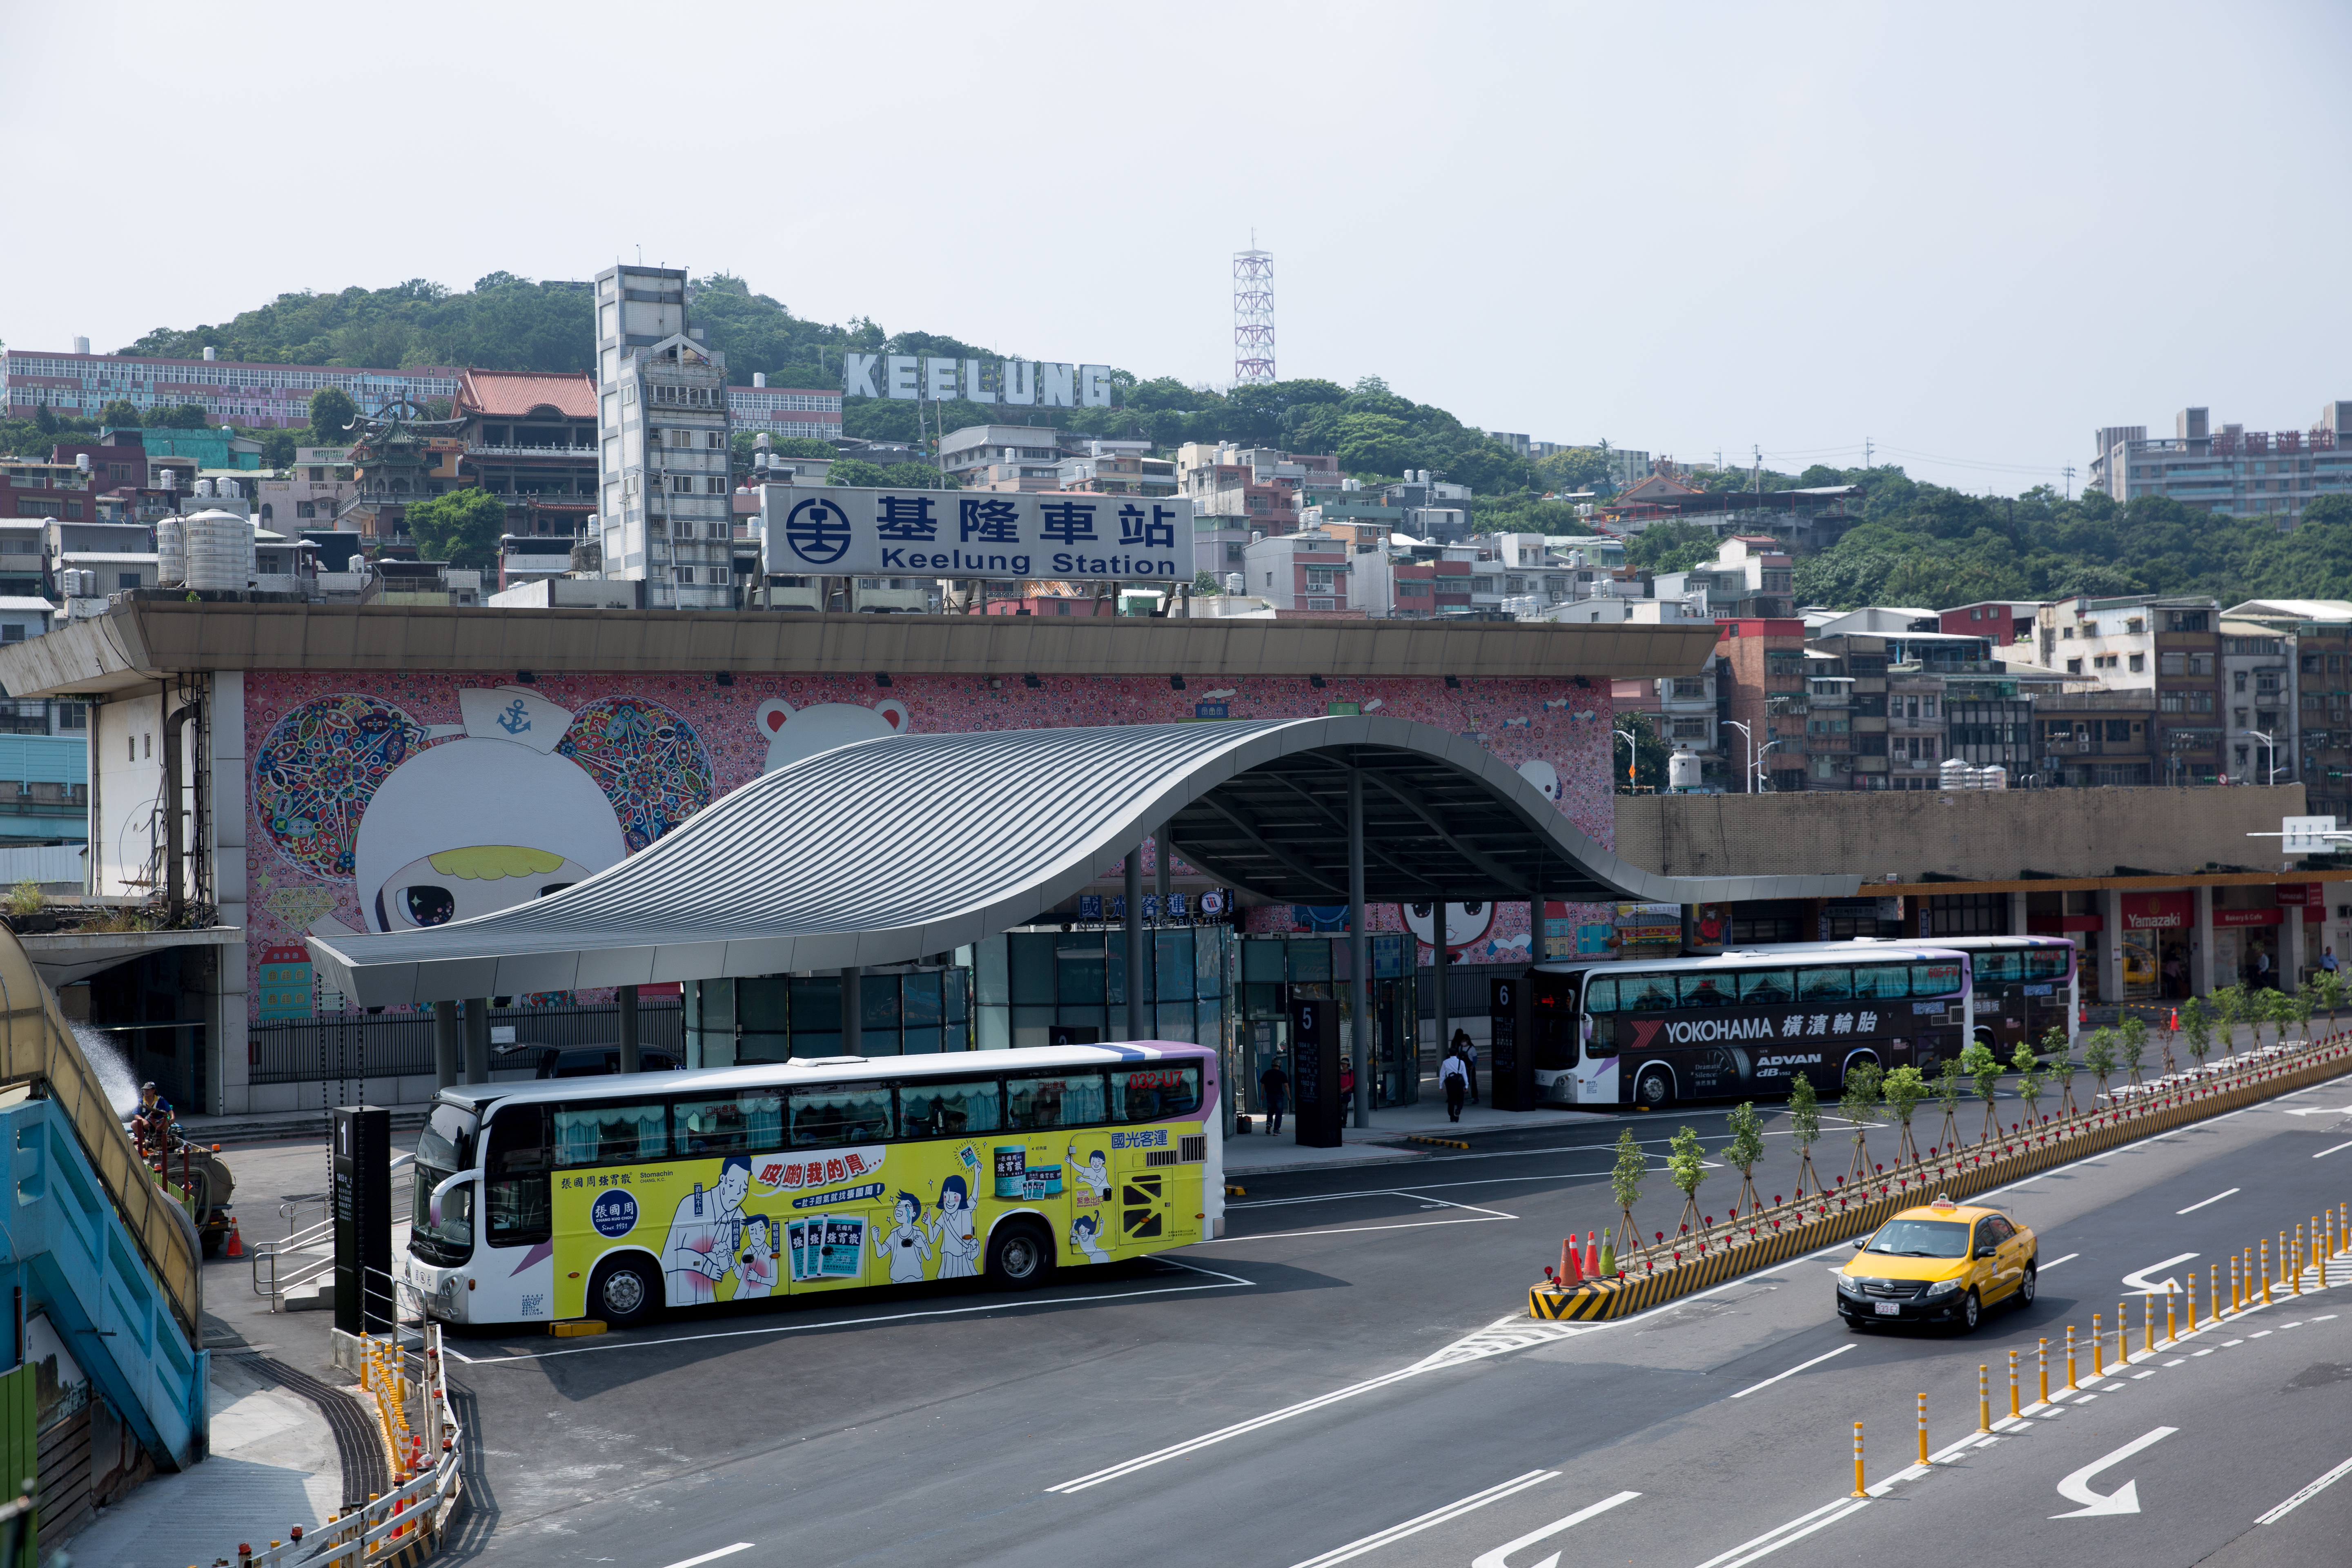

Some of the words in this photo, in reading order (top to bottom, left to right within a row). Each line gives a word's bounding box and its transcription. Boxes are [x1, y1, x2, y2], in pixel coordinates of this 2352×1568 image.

[847, 353, 1111, 408] KEELUNG
[876, 496, 1176, 548] 基隆車站
[882, 548, 1030, 574] Keelung
[1052, 552, 1175, 575] Station
[1078, 892, 1186, 919] 國光客運
[2128, 912, 2180, 928] Yamazaki
[1928, 967, 1958, 978] 605-FW
[1500, 985, 1509, 1005] 6
[1303, 1007, 1312, 1029] 5
[1665, 1017, 1774, 1043] YOKOHAMA
[1756, 1054, 1822, 1067] ADVAN
[1129, 1070, 1183, 1089] 032-U7
[1756, 1068, 1779, 1078] dB
[341, 1121, 346, 1154] 1
[1111, 1129, 1168, 1149] 國光客運
[998, 1161, 1022, 1172] 強胃散
[561, 1174, 632, 1189] 張國周強胃散
[1077, 1195, 1104, 1205] 緊急出口
[595, 1202, 633, 1218] 張國周
[827, 1232, 859, 1244] 強胃散
[426, 1274, 432, 1286] 光
[1875, 1304, 1898, 1314] 533-E7
